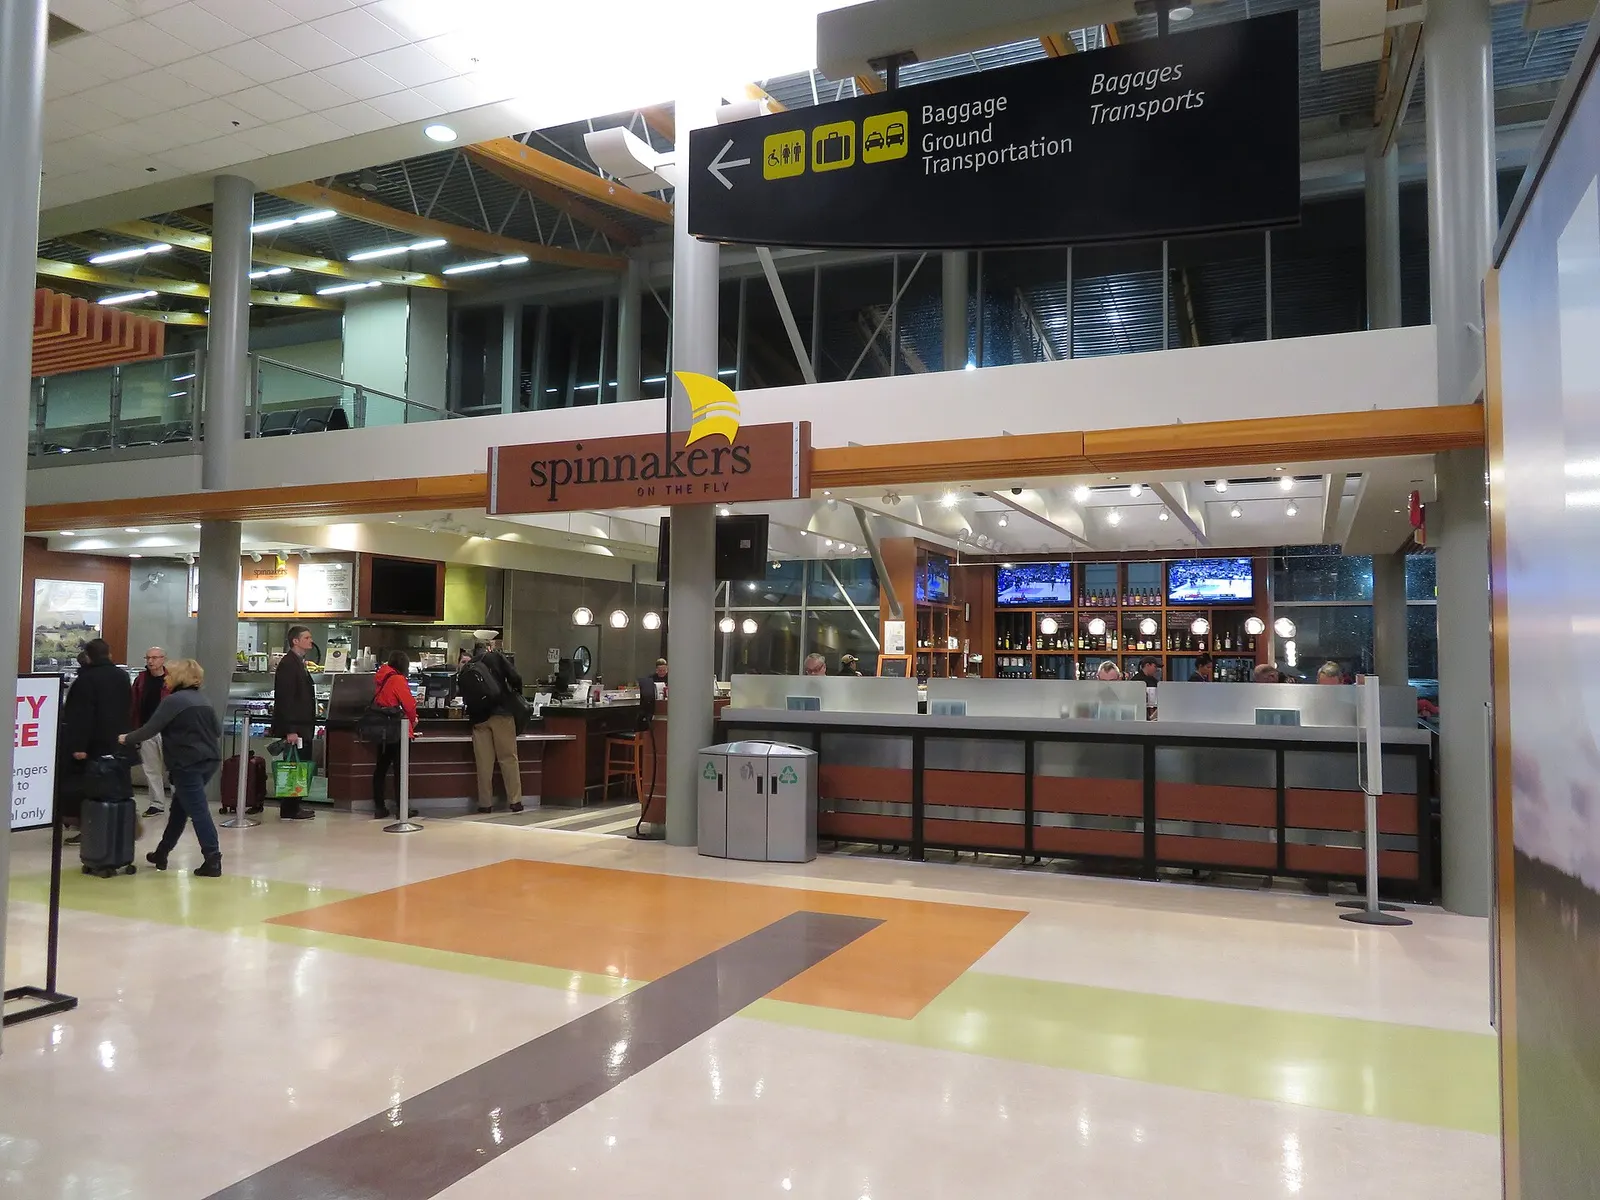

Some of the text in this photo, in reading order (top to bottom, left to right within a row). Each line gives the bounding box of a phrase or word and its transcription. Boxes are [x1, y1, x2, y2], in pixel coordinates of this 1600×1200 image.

[1090, 63, 1183, 97] Bagages
[921, 96, 1008, 125] Baggage
[1090, 89, 1205, 125] Transports
[921, 122, 994, 152] Ground
[921, 136, 1073, 175] Transportation
[530, 442, 752, 501] spinnakers
[637, 481, 730, 498] ON THE FLY
[14, 723, 39, 747] E
[17, 782, 30, 791] to
[14, 797, 27, 806] or
[21, 807, 46, 820] only
